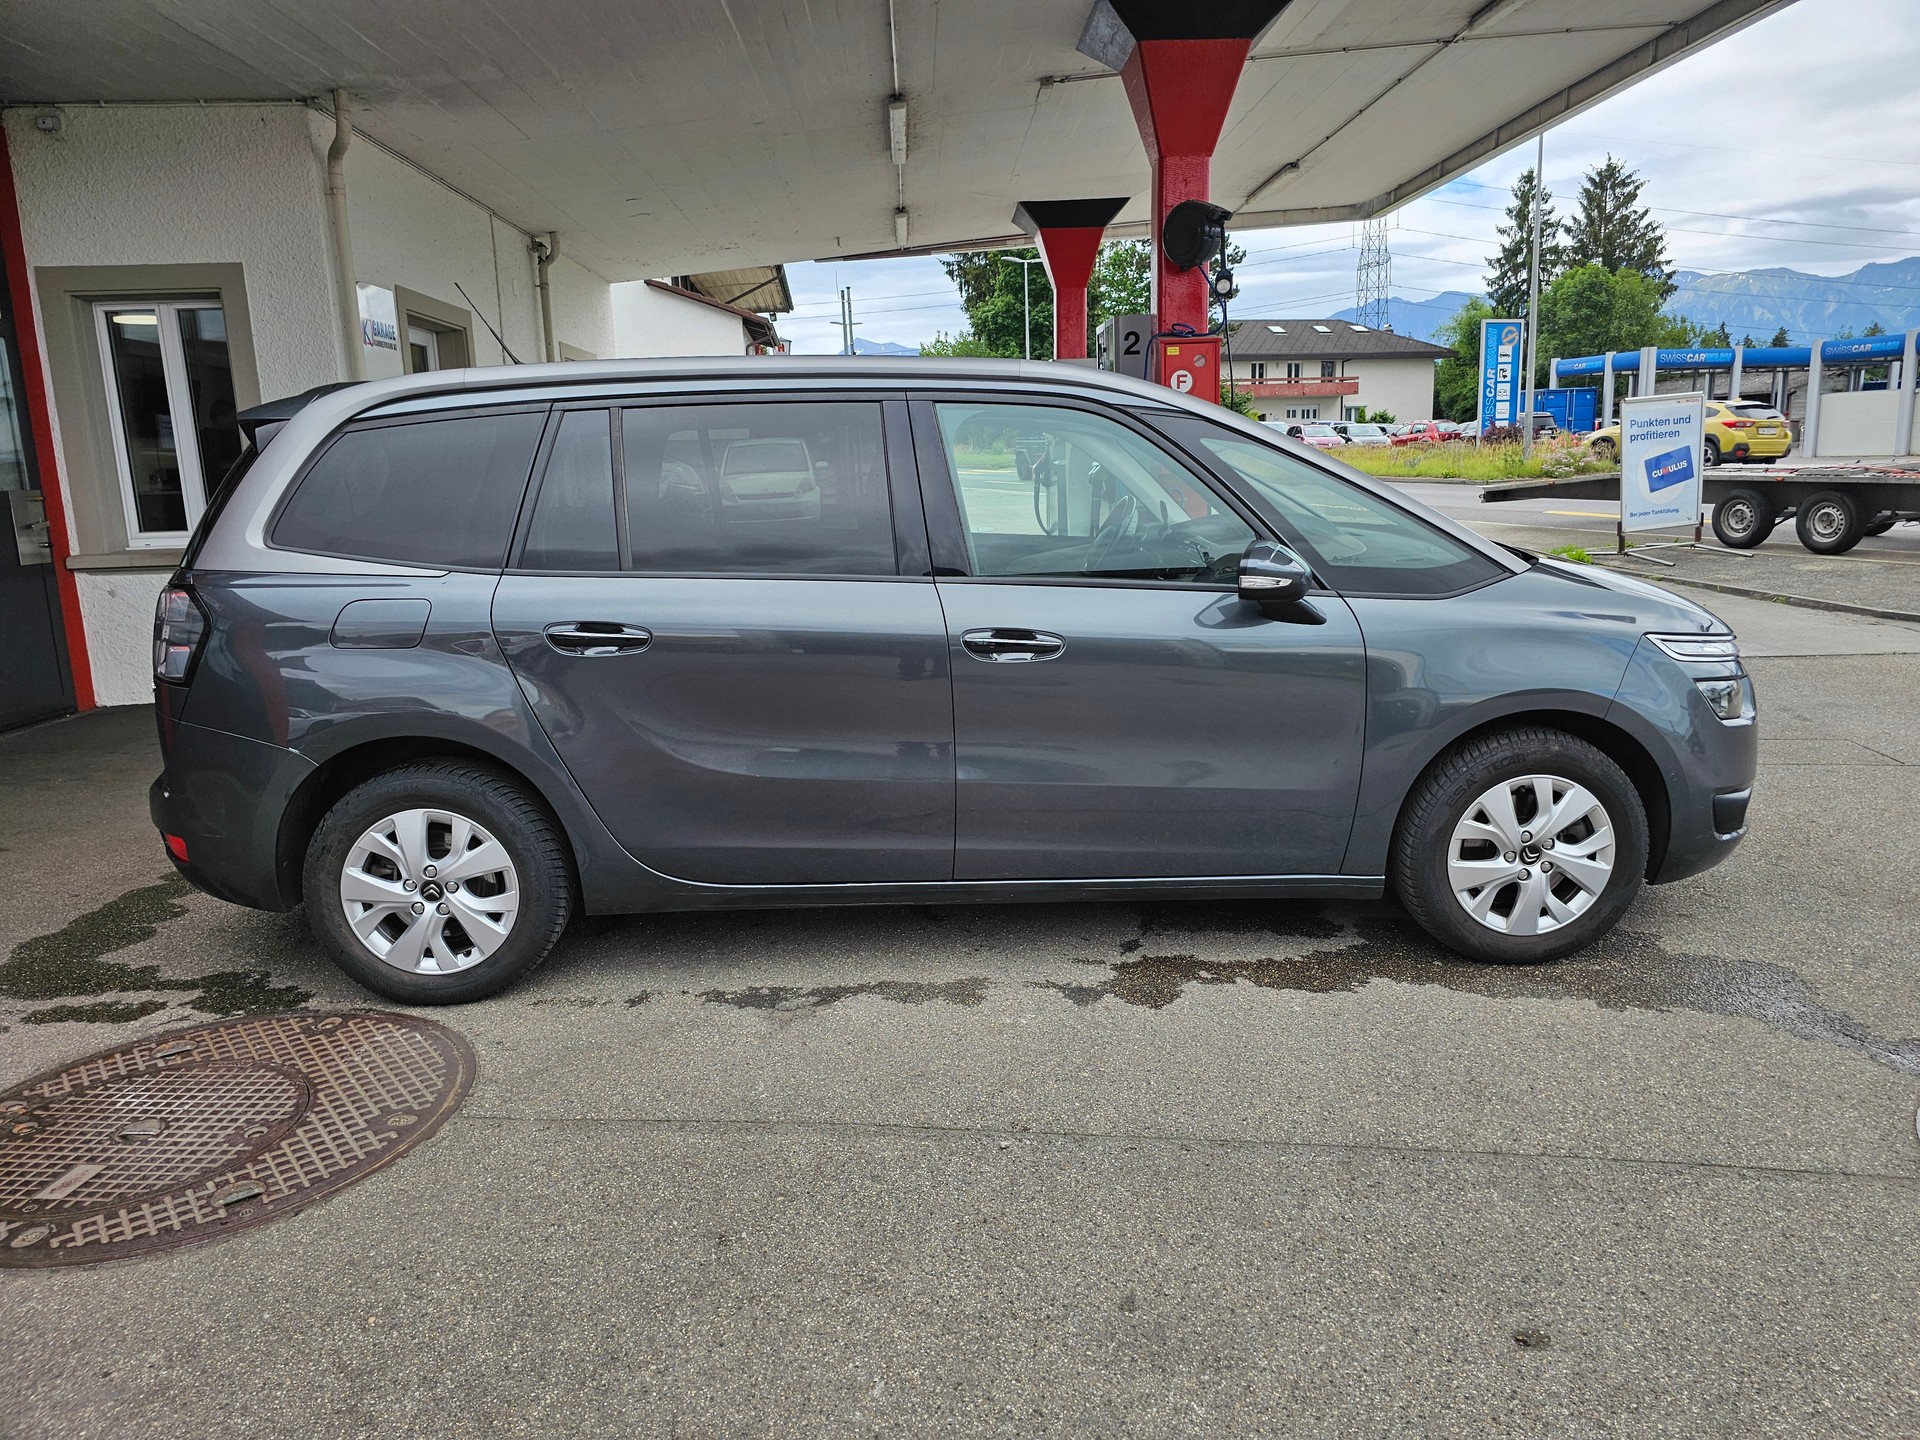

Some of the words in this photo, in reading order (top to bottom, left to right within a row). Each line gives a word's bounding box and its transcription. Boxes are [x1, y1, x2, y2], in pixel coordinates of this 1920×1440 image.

[374, 320, 396, 341] GARAGE
[1123, 331, 1141, 355] 2
[1177, 374, 1188, 389] F
[1630, 418, 1670, 429] Punkten
[1672, 415, 1691, 425] und
[1629, 429, 1680, 443] profitieren
[1652, 460, 1688, 478] CUMULUS
